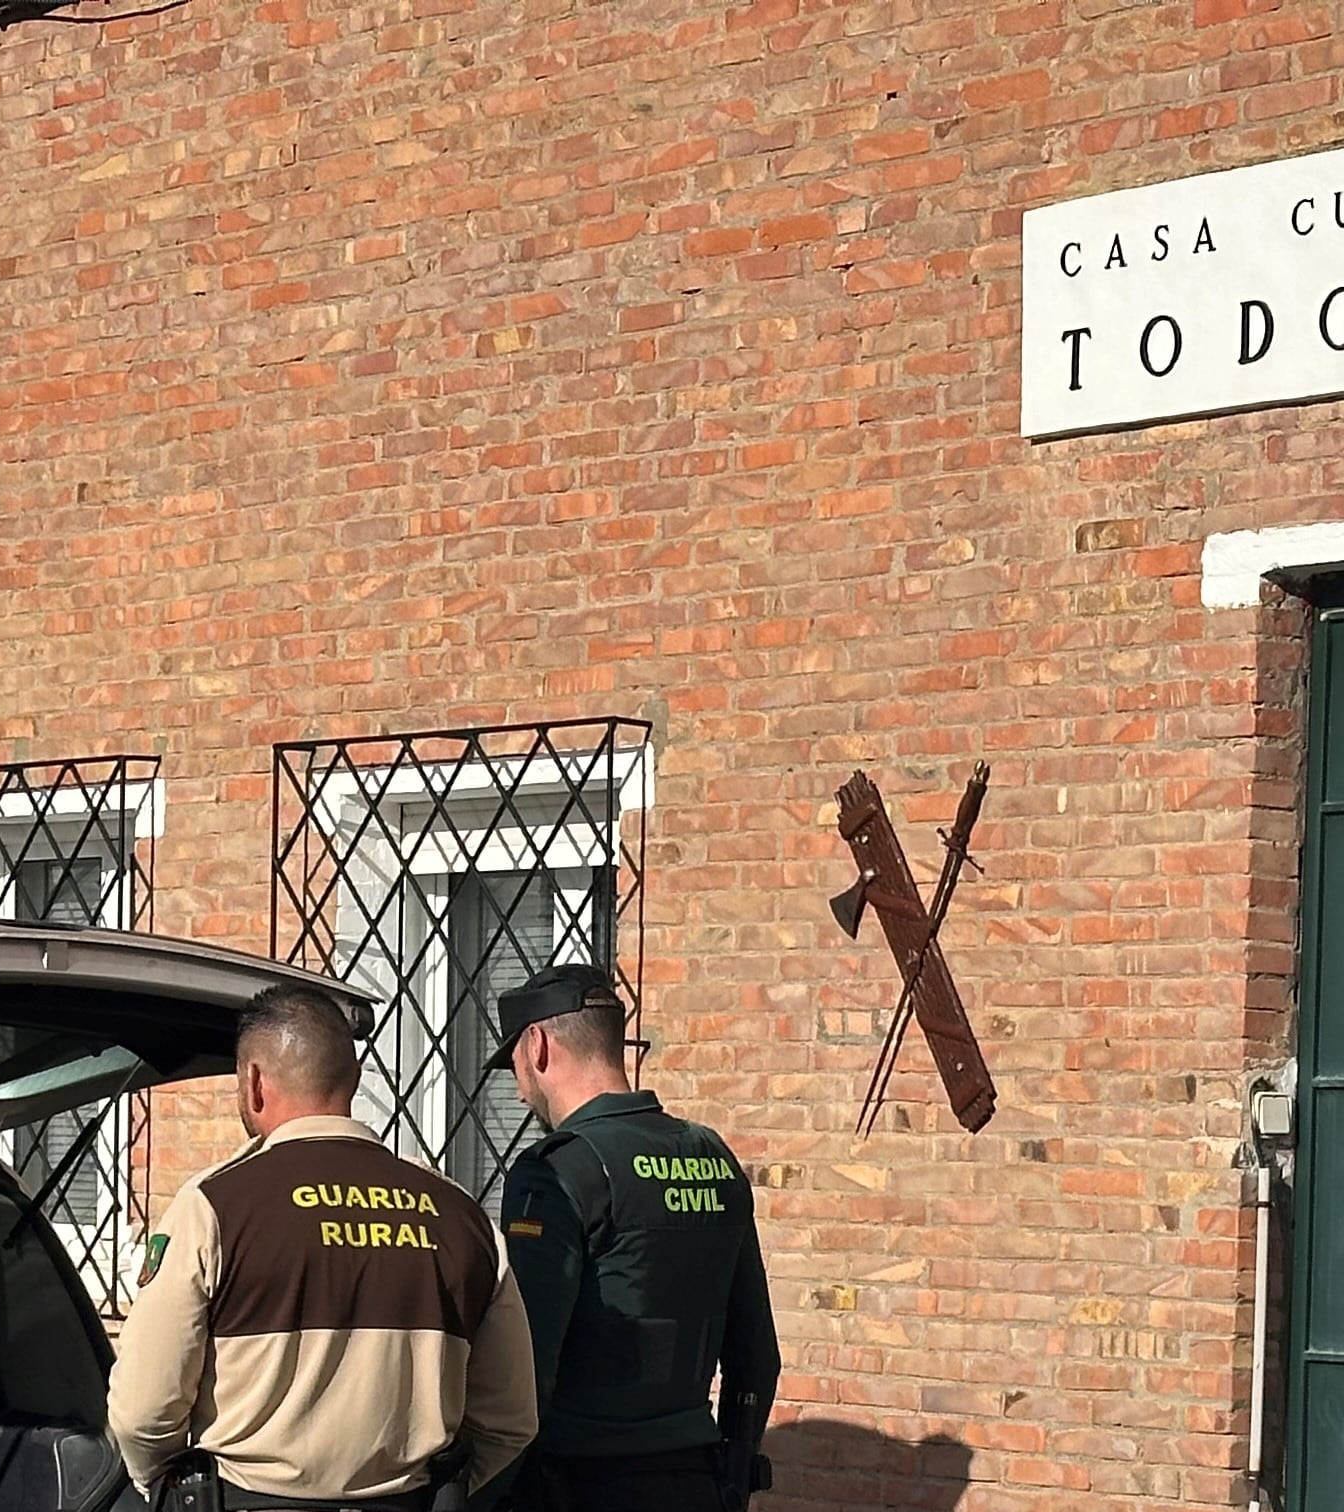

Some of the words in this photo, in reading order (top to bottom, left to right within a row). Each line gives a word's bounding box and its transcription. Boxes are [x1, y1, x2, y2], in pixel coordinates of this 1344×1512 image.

[1059, 217, 1220, 278] CASA
[633, 1154, 736, 1181] GUARDIA
[291, 1183, 440, 1217] GUARDA
[664, 1187, 726, 1213] CIVIL
[319, 1221, 438, 1250] RURAL
